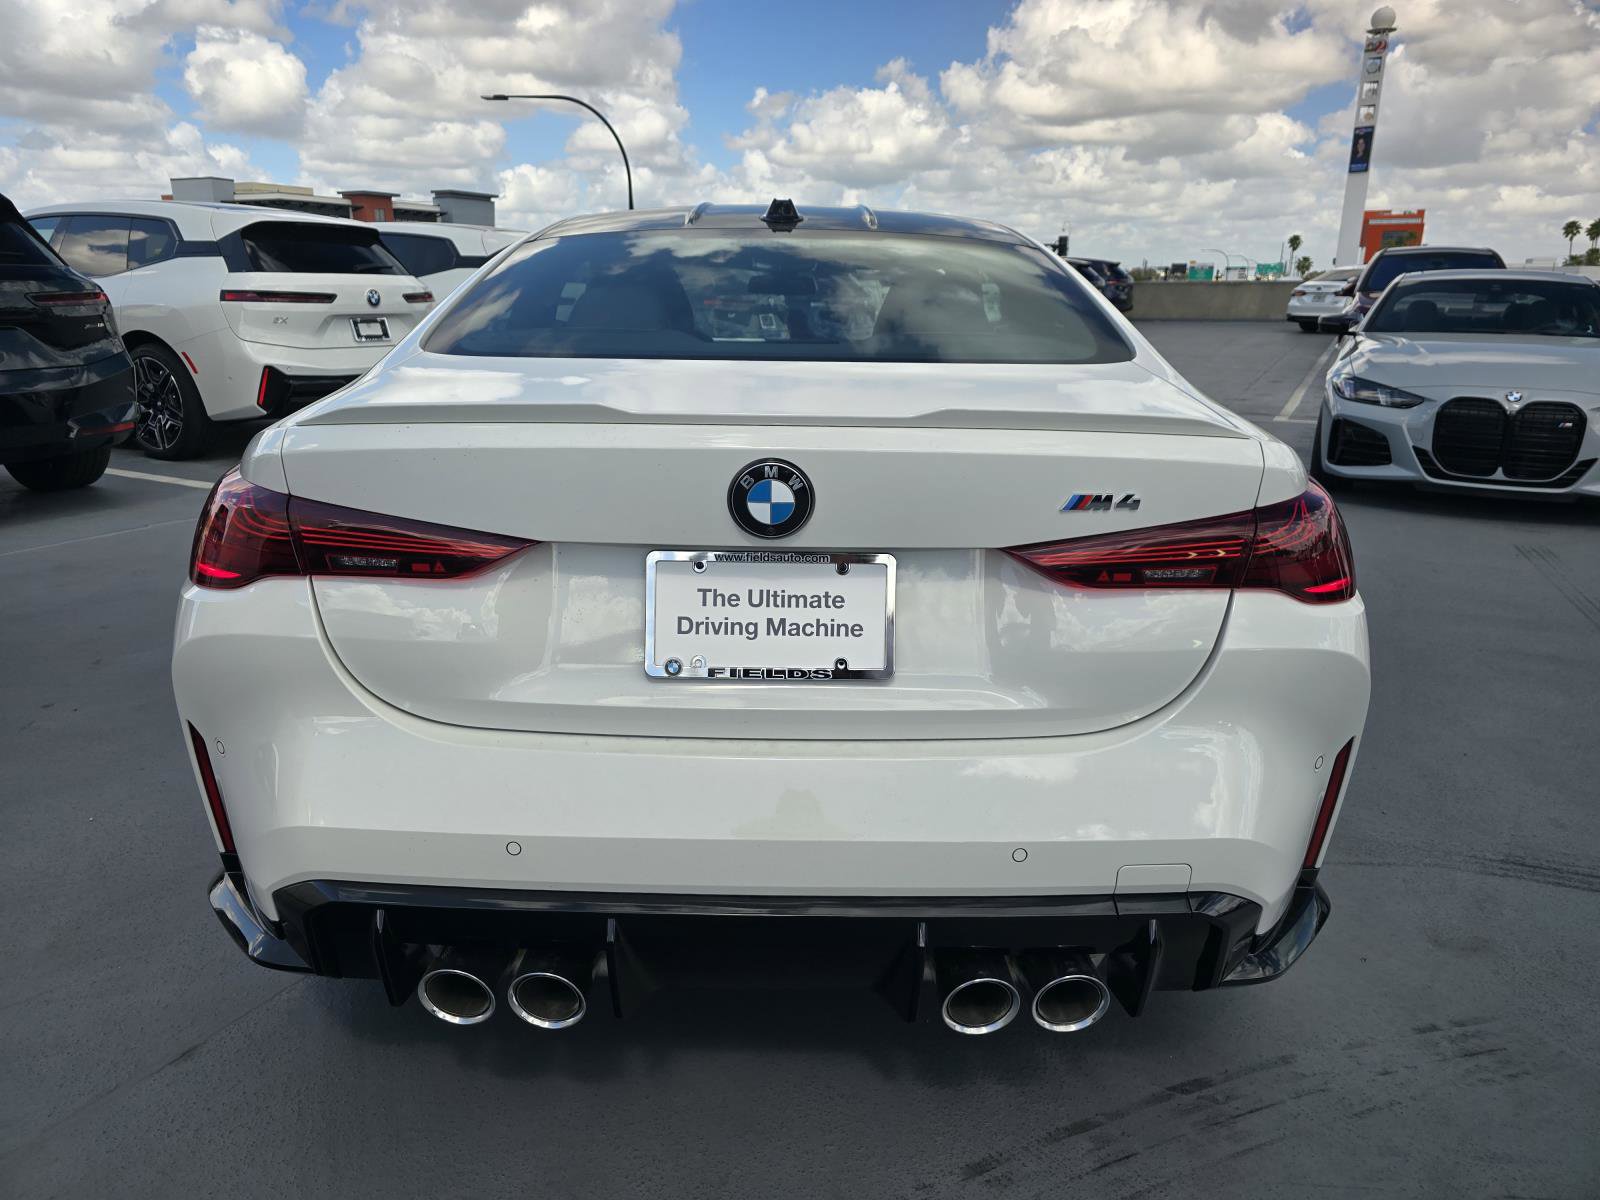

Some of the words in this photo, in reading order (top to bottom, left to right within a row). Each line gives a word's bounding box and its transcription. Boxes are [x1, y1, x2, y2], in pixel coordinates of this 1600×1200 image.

[740, 465, 803, 490] BMW
[714, 552, 830, 563] www.fieldsauto.com
[697, 588, 741, 607] The
[747, 589, 846, 609] Ultimate
[677, 616, 758, 640] Driving
[766, 617, 864, 637] Machine
[707, 667, 832, 680] FIELDS
